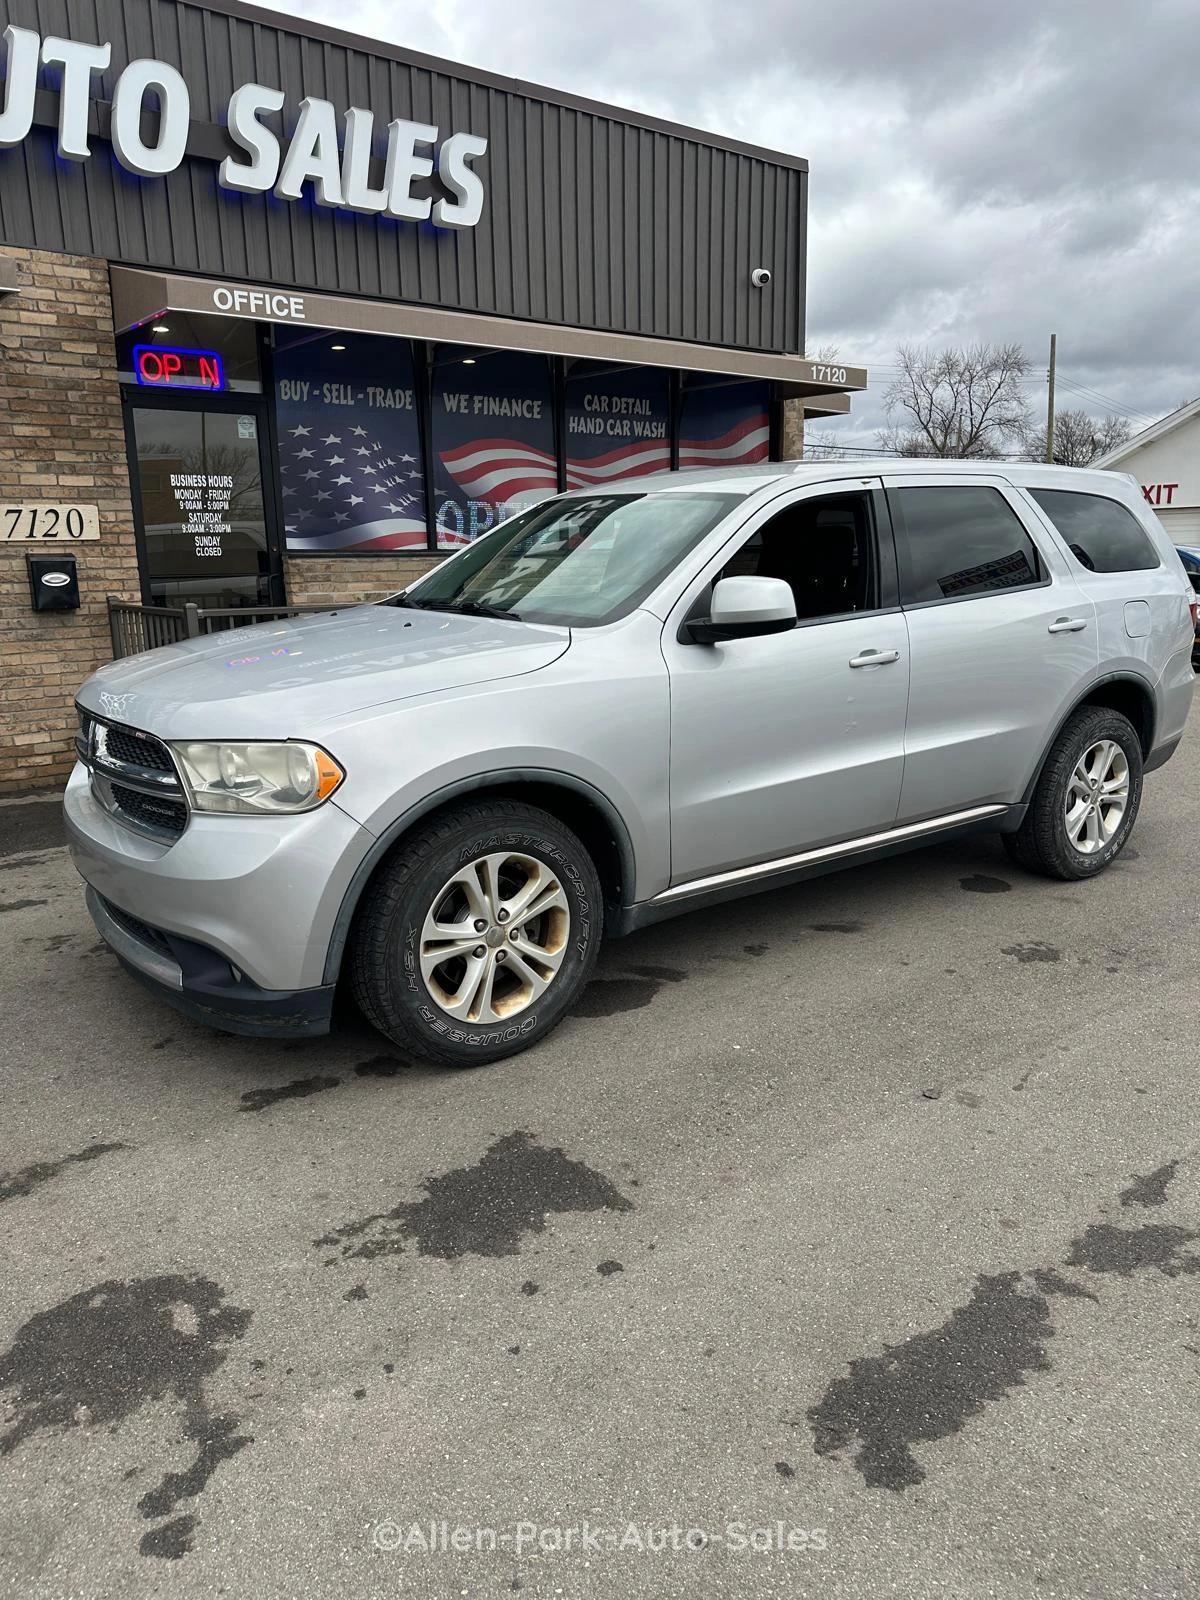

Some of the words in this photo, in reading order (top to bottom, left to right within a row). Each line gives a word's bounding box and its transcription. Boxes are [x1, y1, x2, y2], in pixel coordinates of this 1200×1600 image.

[219, 82, 488, 230] SALES
[213, 288, 305, 318] OFFICE
[139, 352, 221, 386] OPN
[811, 365, 847, 383] 17120
[280, 379, 310, 401] BUY
[322, 383, 354, 405] SELL
[366, 386, 413, 410] TRADE
[443, 392, 469, 413] WE
[473, 395, 542, 419] FINANCE
[584, 394, 609, 413] CAR
[611, 396, 652, 416] DETAIL
[569, 416, 604, 435] HAND
[606, 418, 631, 437] CAR
[632, 420, 666, 438] WASH
[170, 474, 207, 487] BUSINESS
[208, 475, 233, 488] HOURS
[174, 489, 202, 500] MONDAY
[208, 490, 232, 501] FRIDAY
[179, 501, 203, 510] 9:00AM
[207, 501, 230, 510] 5:00PM
[4, 508, 84, 538] 7120
[181, 524, 205, 533] 9:00AM
[209, 524, 232, 533] 3:00PM
[188, 512, 222, 523] SATURDAY
[194, 536, 221, 546] SUNDAY
[195, 547, 222, 556] CLOSED
[459, 833, 591, 961] MASTERCRAFT
[417, 1005, 538, 1046] COURSER
